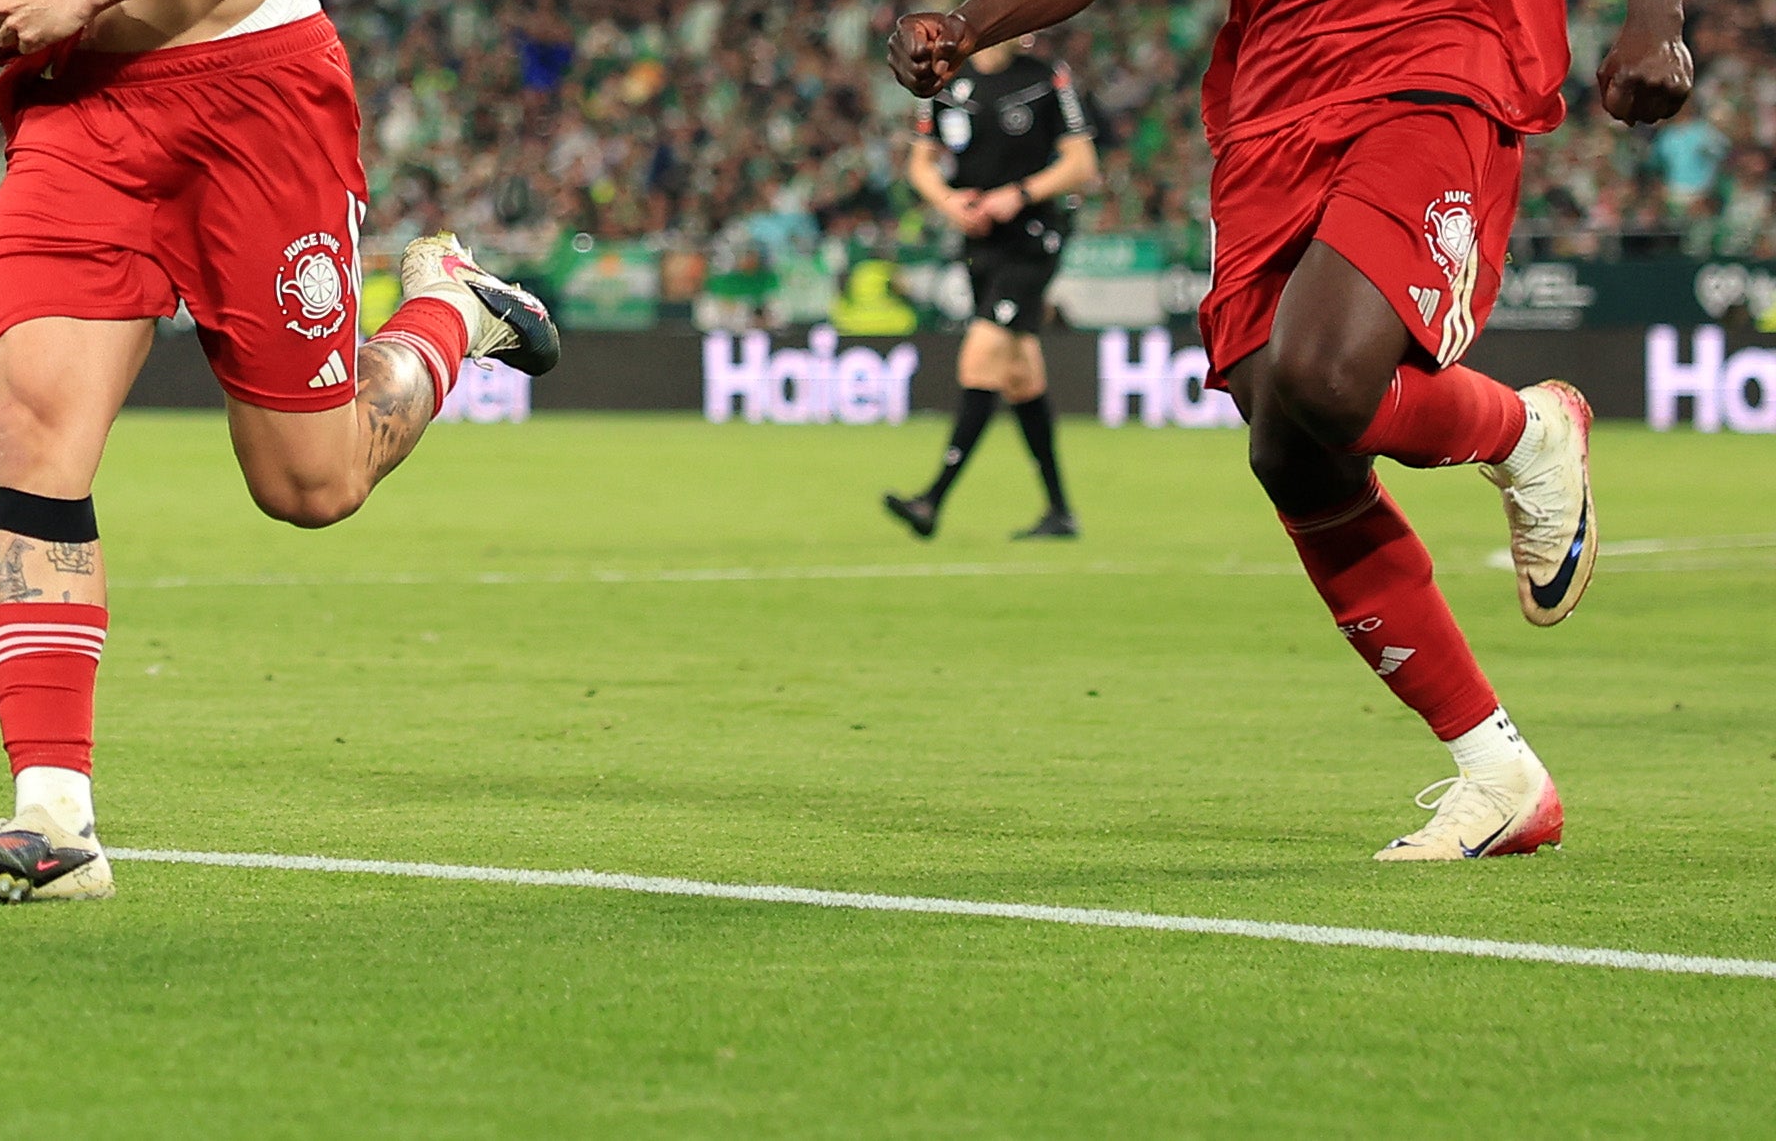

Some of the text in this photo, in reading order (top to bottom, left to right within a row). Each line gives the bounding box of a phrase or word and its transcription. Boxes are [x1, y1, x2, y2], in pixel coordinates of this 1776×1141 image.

[1444, 191, 1472, 205] JUIC
[283, 232, 341, 262] JUICE TIME
[702, 322, 920, 427] Haier
